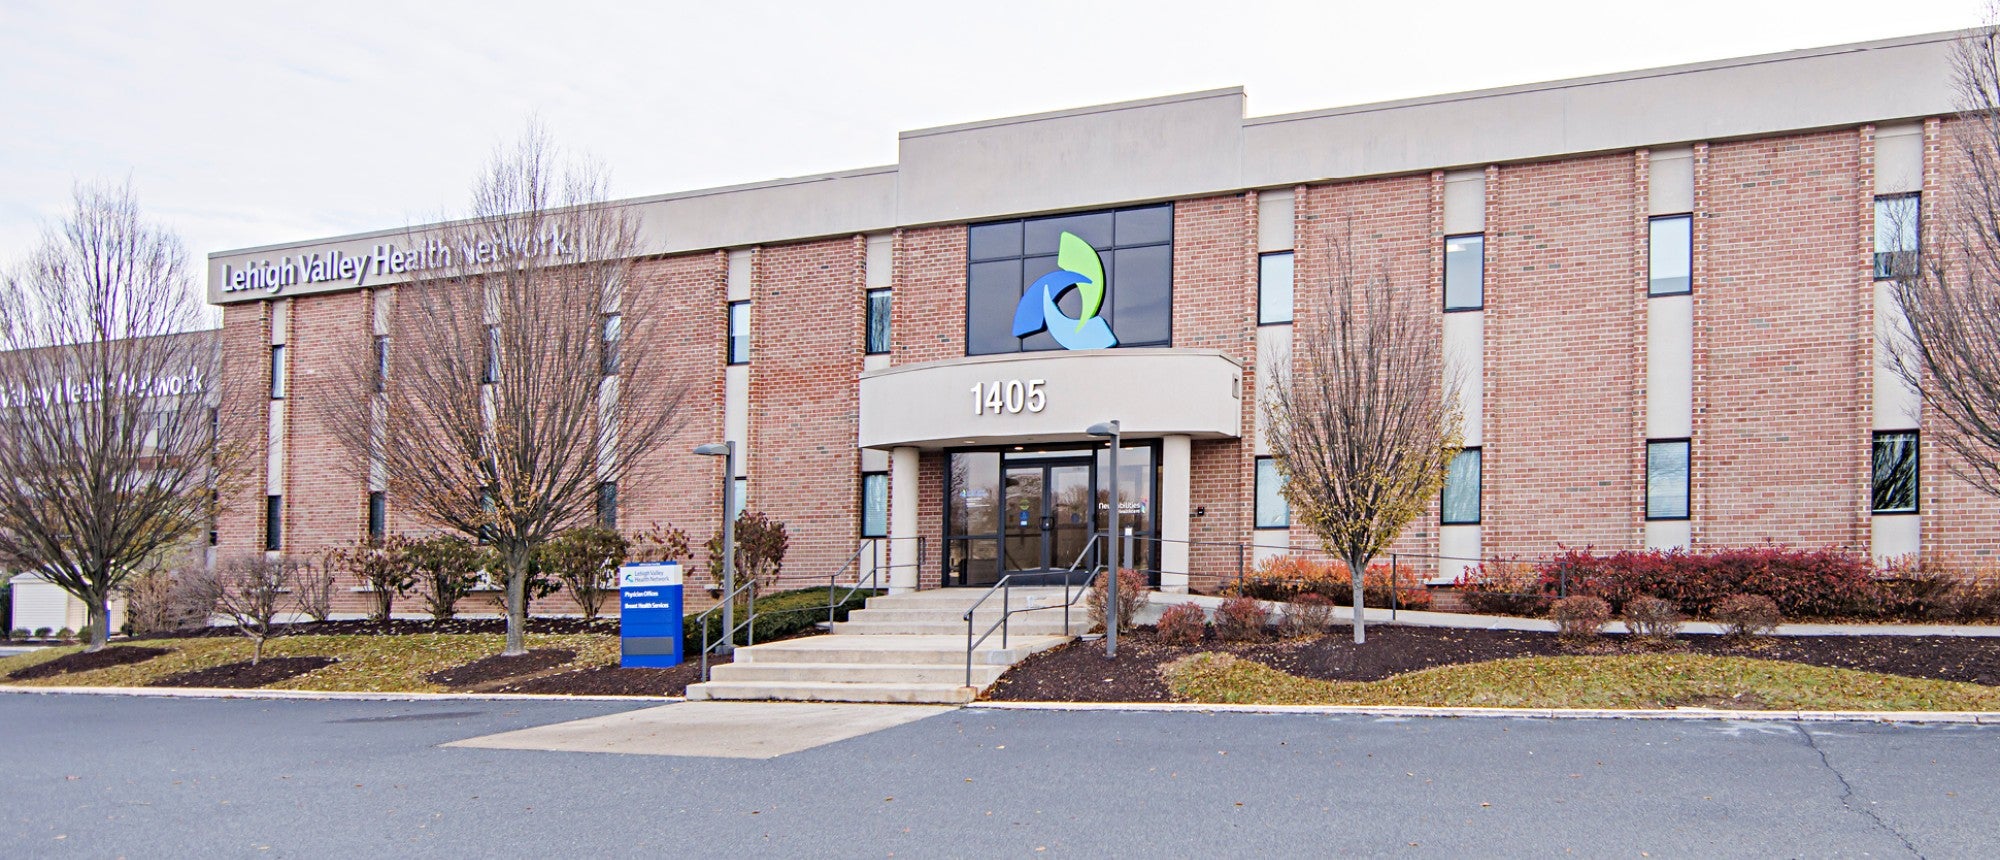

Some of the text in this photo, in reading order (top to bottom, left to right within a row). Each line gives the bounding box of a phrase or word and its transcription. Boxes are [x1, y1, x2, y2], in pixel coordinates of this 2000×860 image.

[221, 224, 571, 293] Lehigh Valley Health Network
[56, 376, 116, 404] Healt
[971, 379, 1046, 415] 1405
[634, 570, 650, 578] Lehigh
